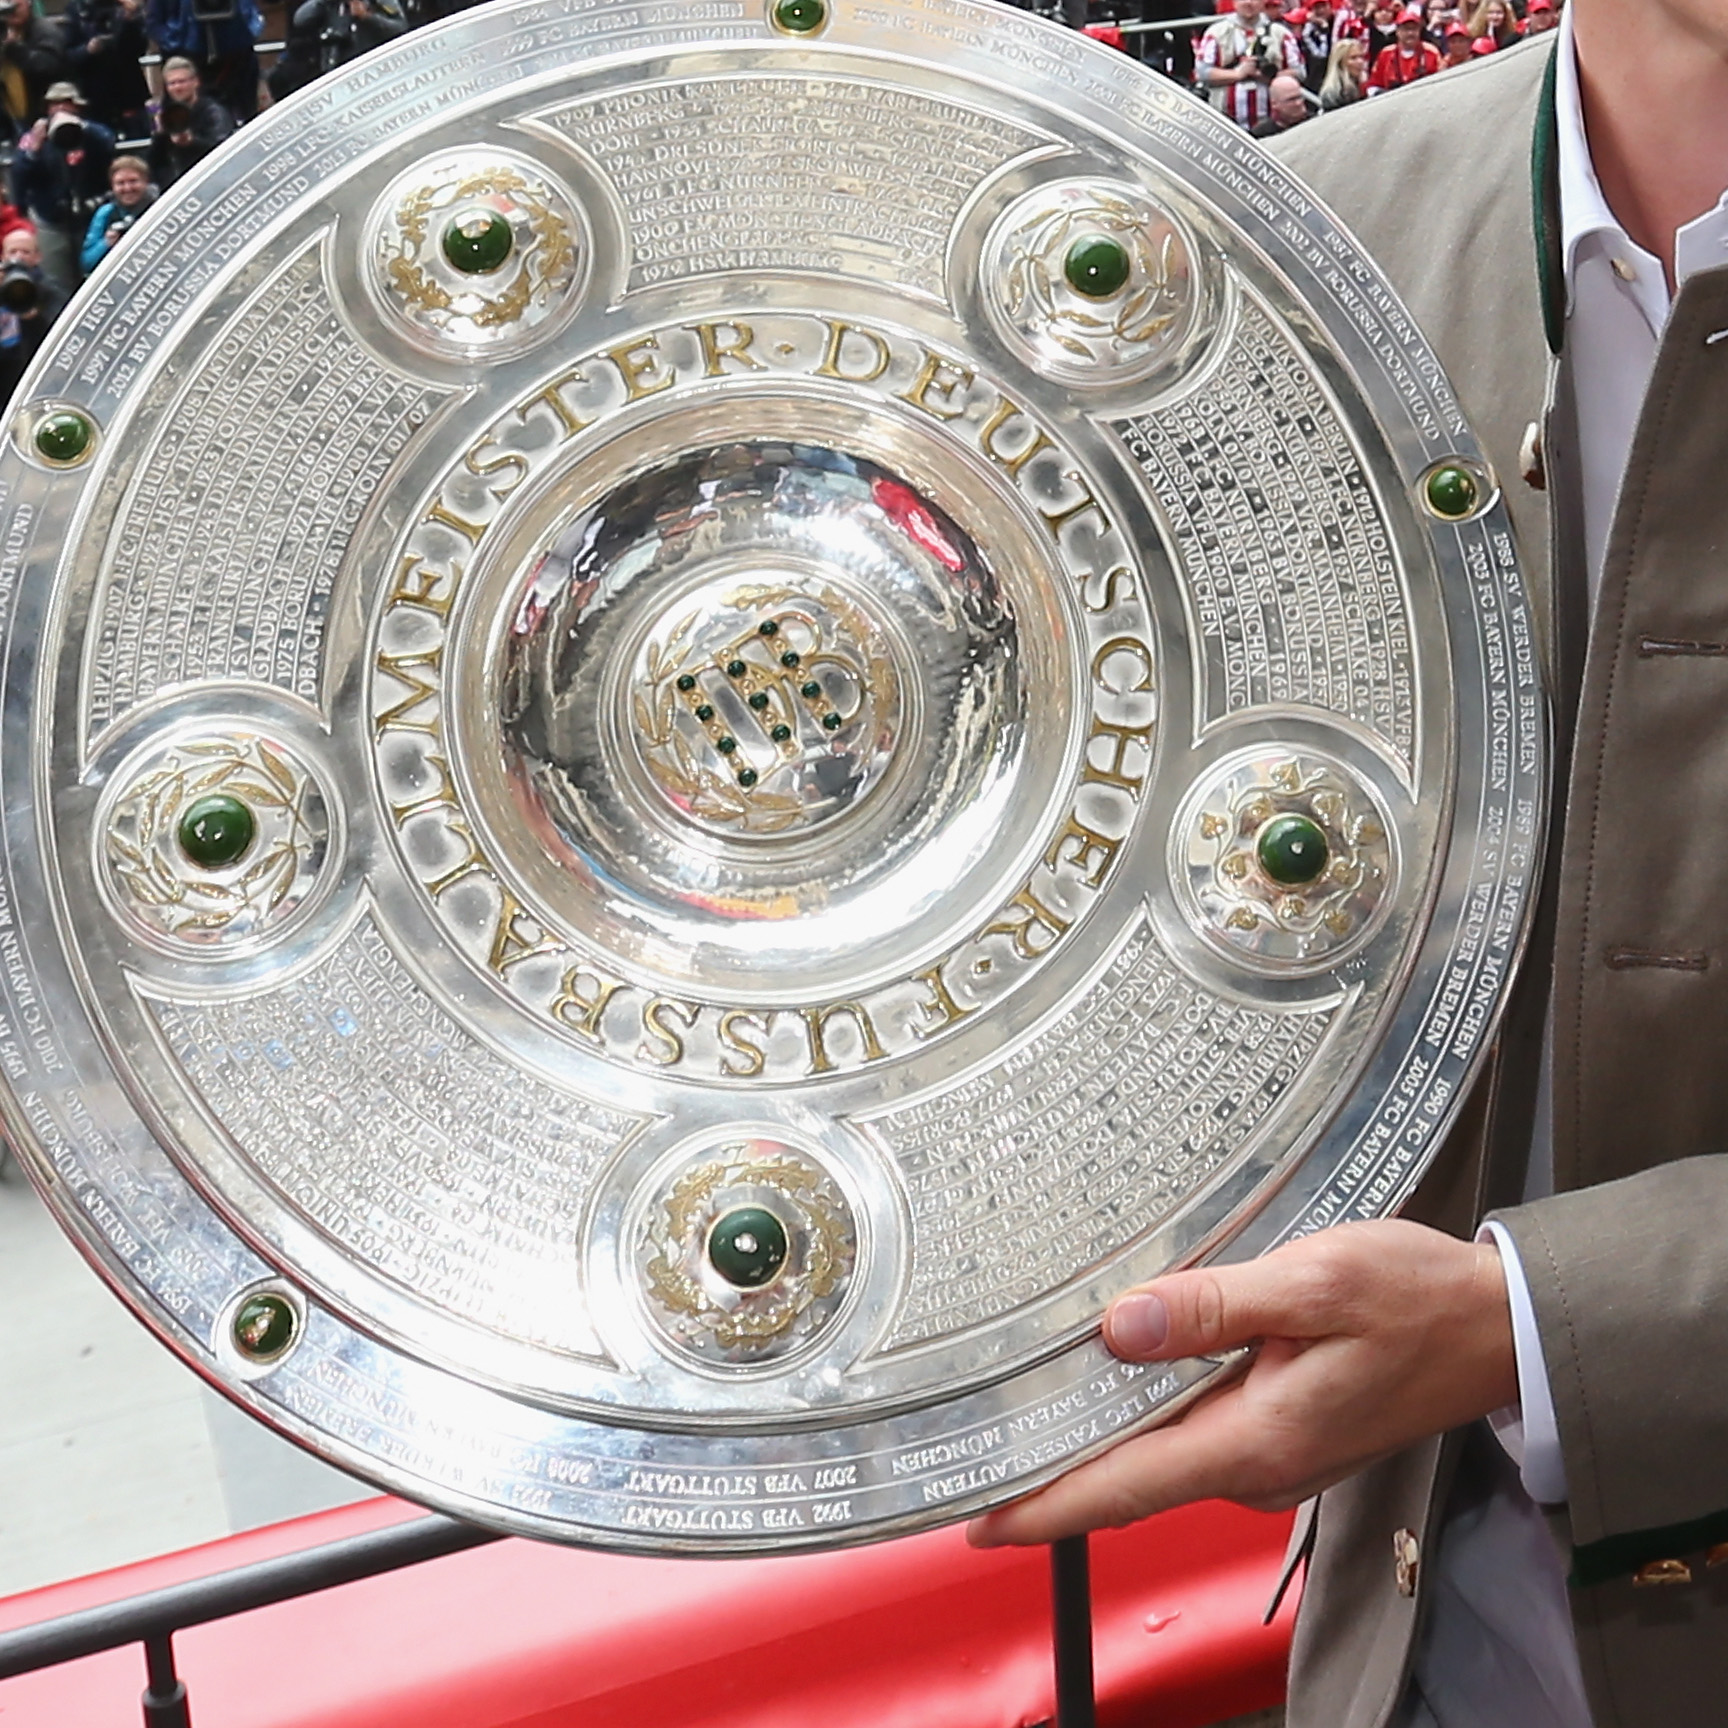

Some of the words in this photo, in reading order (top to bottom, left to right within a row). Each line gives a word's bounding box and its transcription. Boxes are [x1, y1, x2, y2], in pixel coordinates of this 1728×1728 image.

[1168, 99, 1234, 151] BAYERN
[1231, 141, 1316, 218] MÜNCHEN
[1200, 148, 1284, 222] MÜNCHEN
[54, 331, 87, 372] 1982
[81, 289, 118, 333] HSV
[114, 192, 203, 287] HAMBURG
[79, 347, 112, 387] 1997
[101, 321, 130, 352] FC
[119, 258, 180, 327] BAYERN
[170, 178, 259, 264] MÜNCHEN
[105, 360, 139, 399] 2012
[128, 334, 156, 364] BV
[144, 255, 221, 340] BORUSSIA
[212, 172, 313, 263] DORTMUND
[1303, 247, 1327, 272] BV
[1321, 267, 1384, 346] BORUSSIA
[1376, 341, 1440, 443] DORTMUND
[1345, 259, 1371, 286] FC
[1363, 281, 1415, 347] BAYERN
[1409, 344, 1469, 438] MÜNCHEN
[1119, 426, 1148, 458] FC
[1139, 455, 1190, 533] BAYERN
[1136, 416, 1198, 506] BORUSSIA
[1156, 409, 1187, 448] 1972
[1200, 484, 1247, 565] BAYERN
[1317, 410, 1357, 475] BERLIN
[1351, 485, 1376, 523] 1912
[1189, 506, 1217, 544] VFL
[1461, 541, 1488, 582] 2003
[1491, 531, 1515, 569] 1988
[1202, 545, 1232, 591] 1900
[1364, 520, 1400, 615] HOLSTEIN
[1387, 617, 1407, 659] KIEL
[1474, 582, 1494, 609] FC
[1500, 570, 1521, 598] SV
[823, 319, 1154, 959] DEUTSCHER
[1309, 549, 1345, 661] MANNHEIM
[1330, 546, 1351, 586] 1937
[1342, 590, 1368, 680] SCHALKE
[1479, 611, 1505, 683] BAYERN
[1507, 604, 1533, 687] WERDER
[1489, 689, 1511, 790] MÜNCHEN
[1518, 693, 1535, 775] BREMEN
[1478, 848, 1497, 877] SV
[1507, 841, 1527, 869] FC
[1454, 881, 1492, 964] WERDER
[1489, 873, 1522, 949] BAYERN
[20, 1005, 48, 1036] FC
[1421, 964, 1469, 1047] BREMEN
[1448, 954, 1506, 1061] MÜNCHEN
[32, 1034, 64, 1075] 2010
[1397, 1055, 1431, 1096] 2005
[1380, 1092, 1411, 1125] FC
[1403, 1115, 1431, 1145] FC
[1420, 1075, 1453, 1115] 1990
[16, 1089, 91, 1192] MÜNCHEN
[1332, 1121, 1393, 1195] BAYERN
[1353, 1144, 1414, 1217] BAYERN
[79, 1186, 142, 1259] BAYERN
[132, 1252, 164, 1283] FC
[1007, 1388, 1088, 1439] BAYERN
[1088, 1371, 1120, 1400] FC
[1142, 1369, 1182, 1404] 1991
[623, 1469, 758, 1495] STUTTGART
[764, 1471, 807, 1493] VFB
[812, 1464, 859, 1488] 2007
[889, 1425, 1005, 1479] MÜNCHEN
[921, 1417, 1102, 1503] KAISERSLAUTERN
[620, 1502, 753, 1528] STUTTGART
[761, 1505, 804, 1525] VFB
[811, 1499, 852, 1521] 1992
